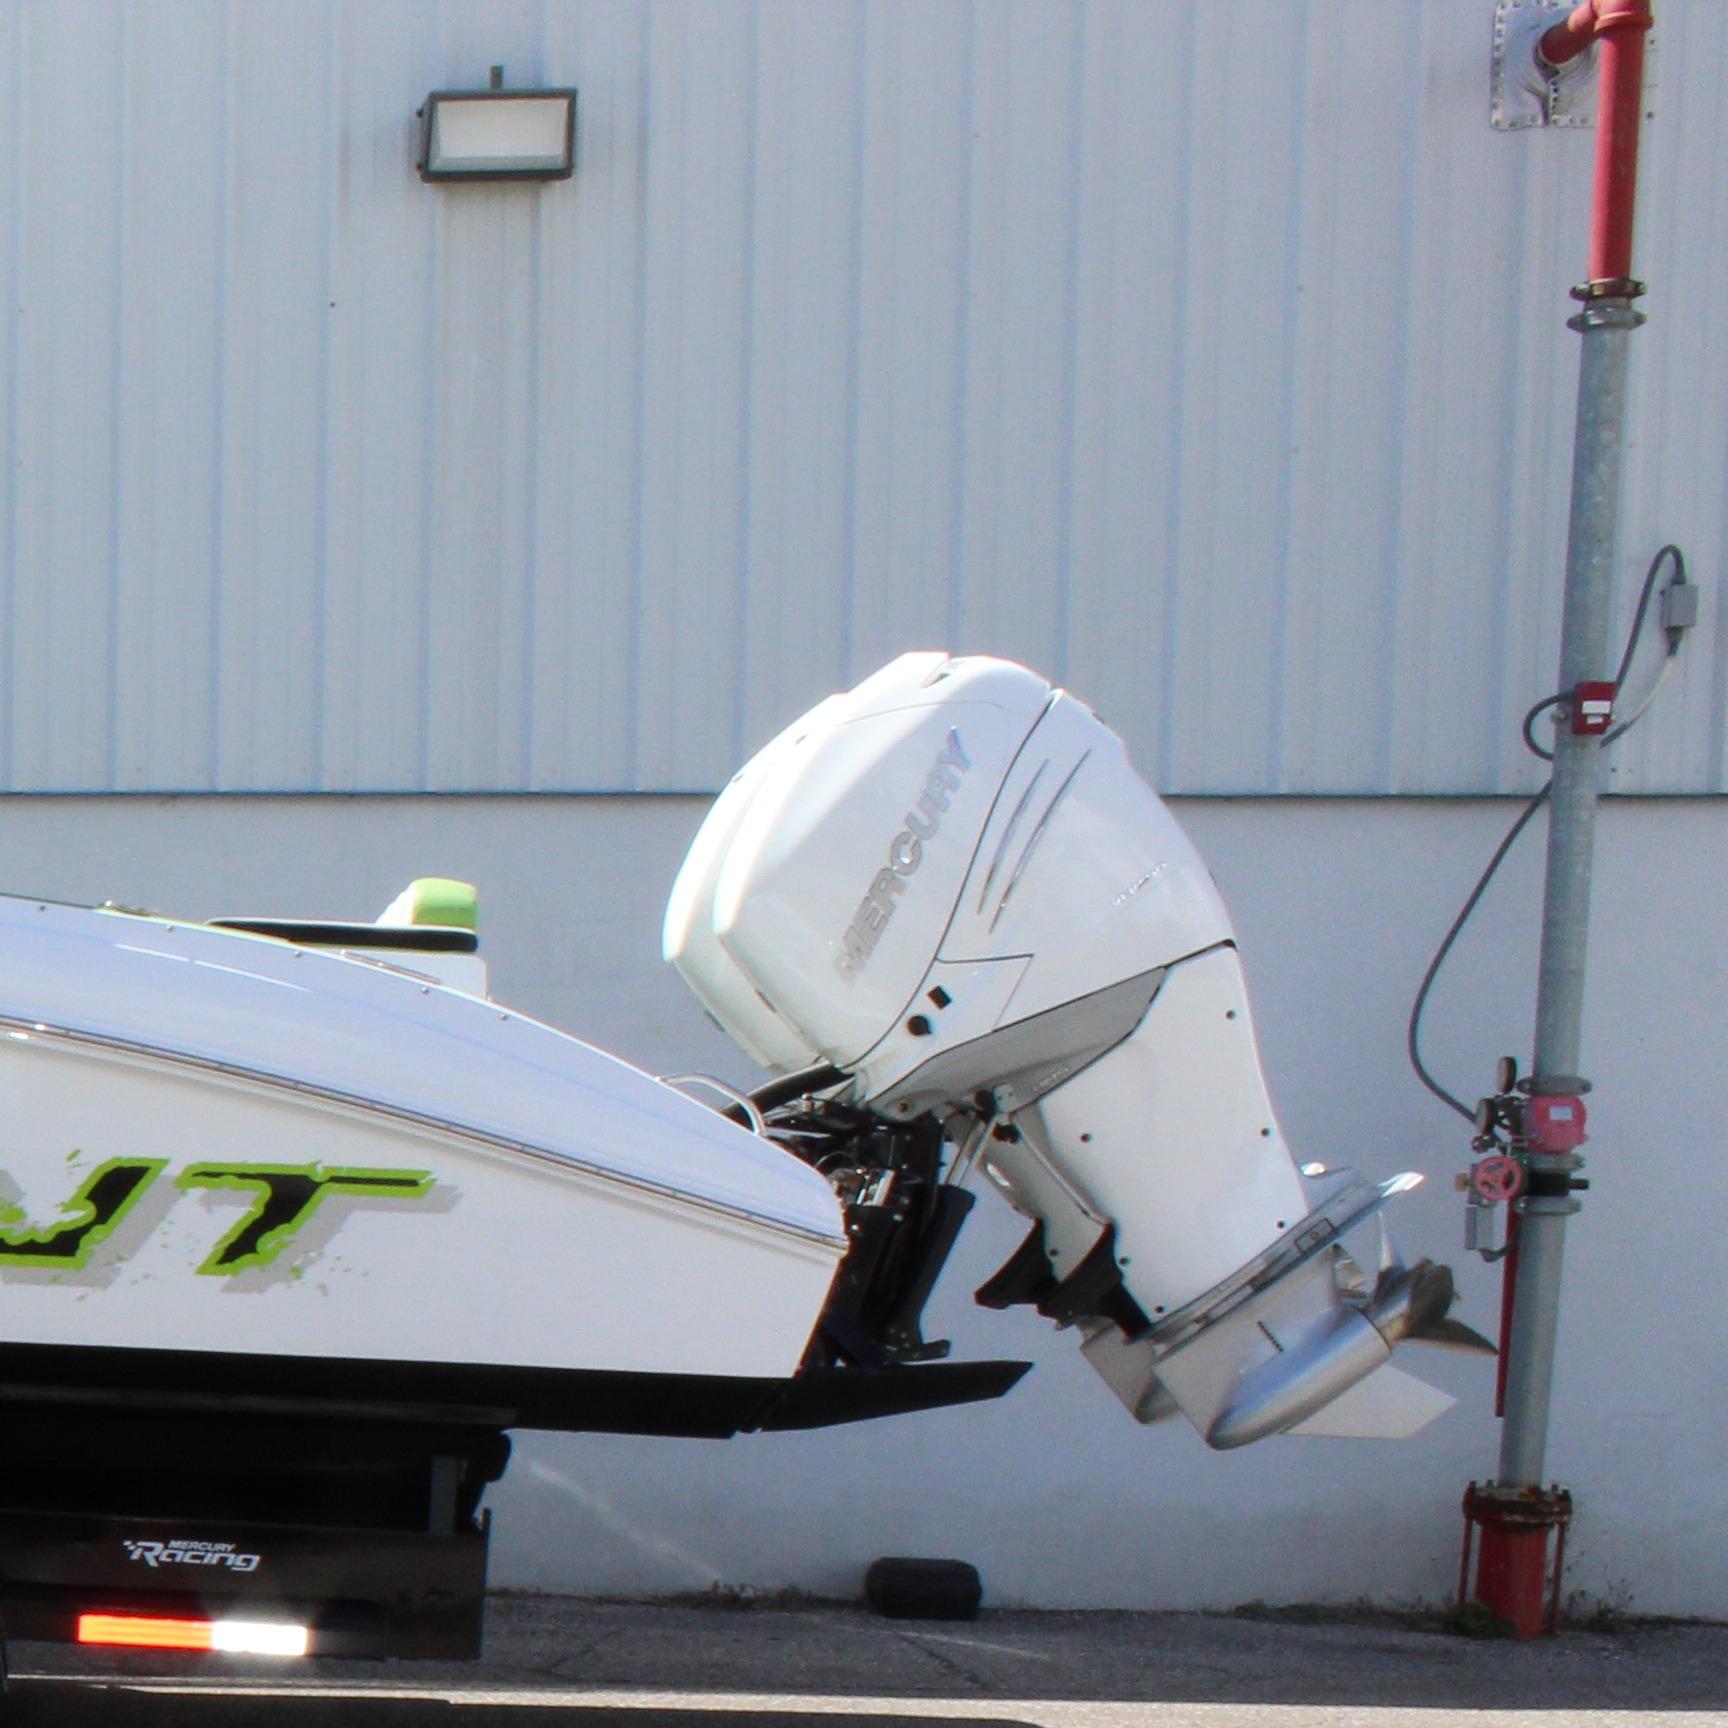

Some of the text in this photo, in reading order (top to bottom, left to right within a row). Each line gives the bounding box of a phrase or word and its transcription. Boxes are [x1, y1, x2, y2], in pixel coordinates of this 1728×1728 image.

[833, 727, 971, 982] MERCURY
[123, 1540, 261, 1572] Racing
[167, 1539, 237, 1552] MERCURY
